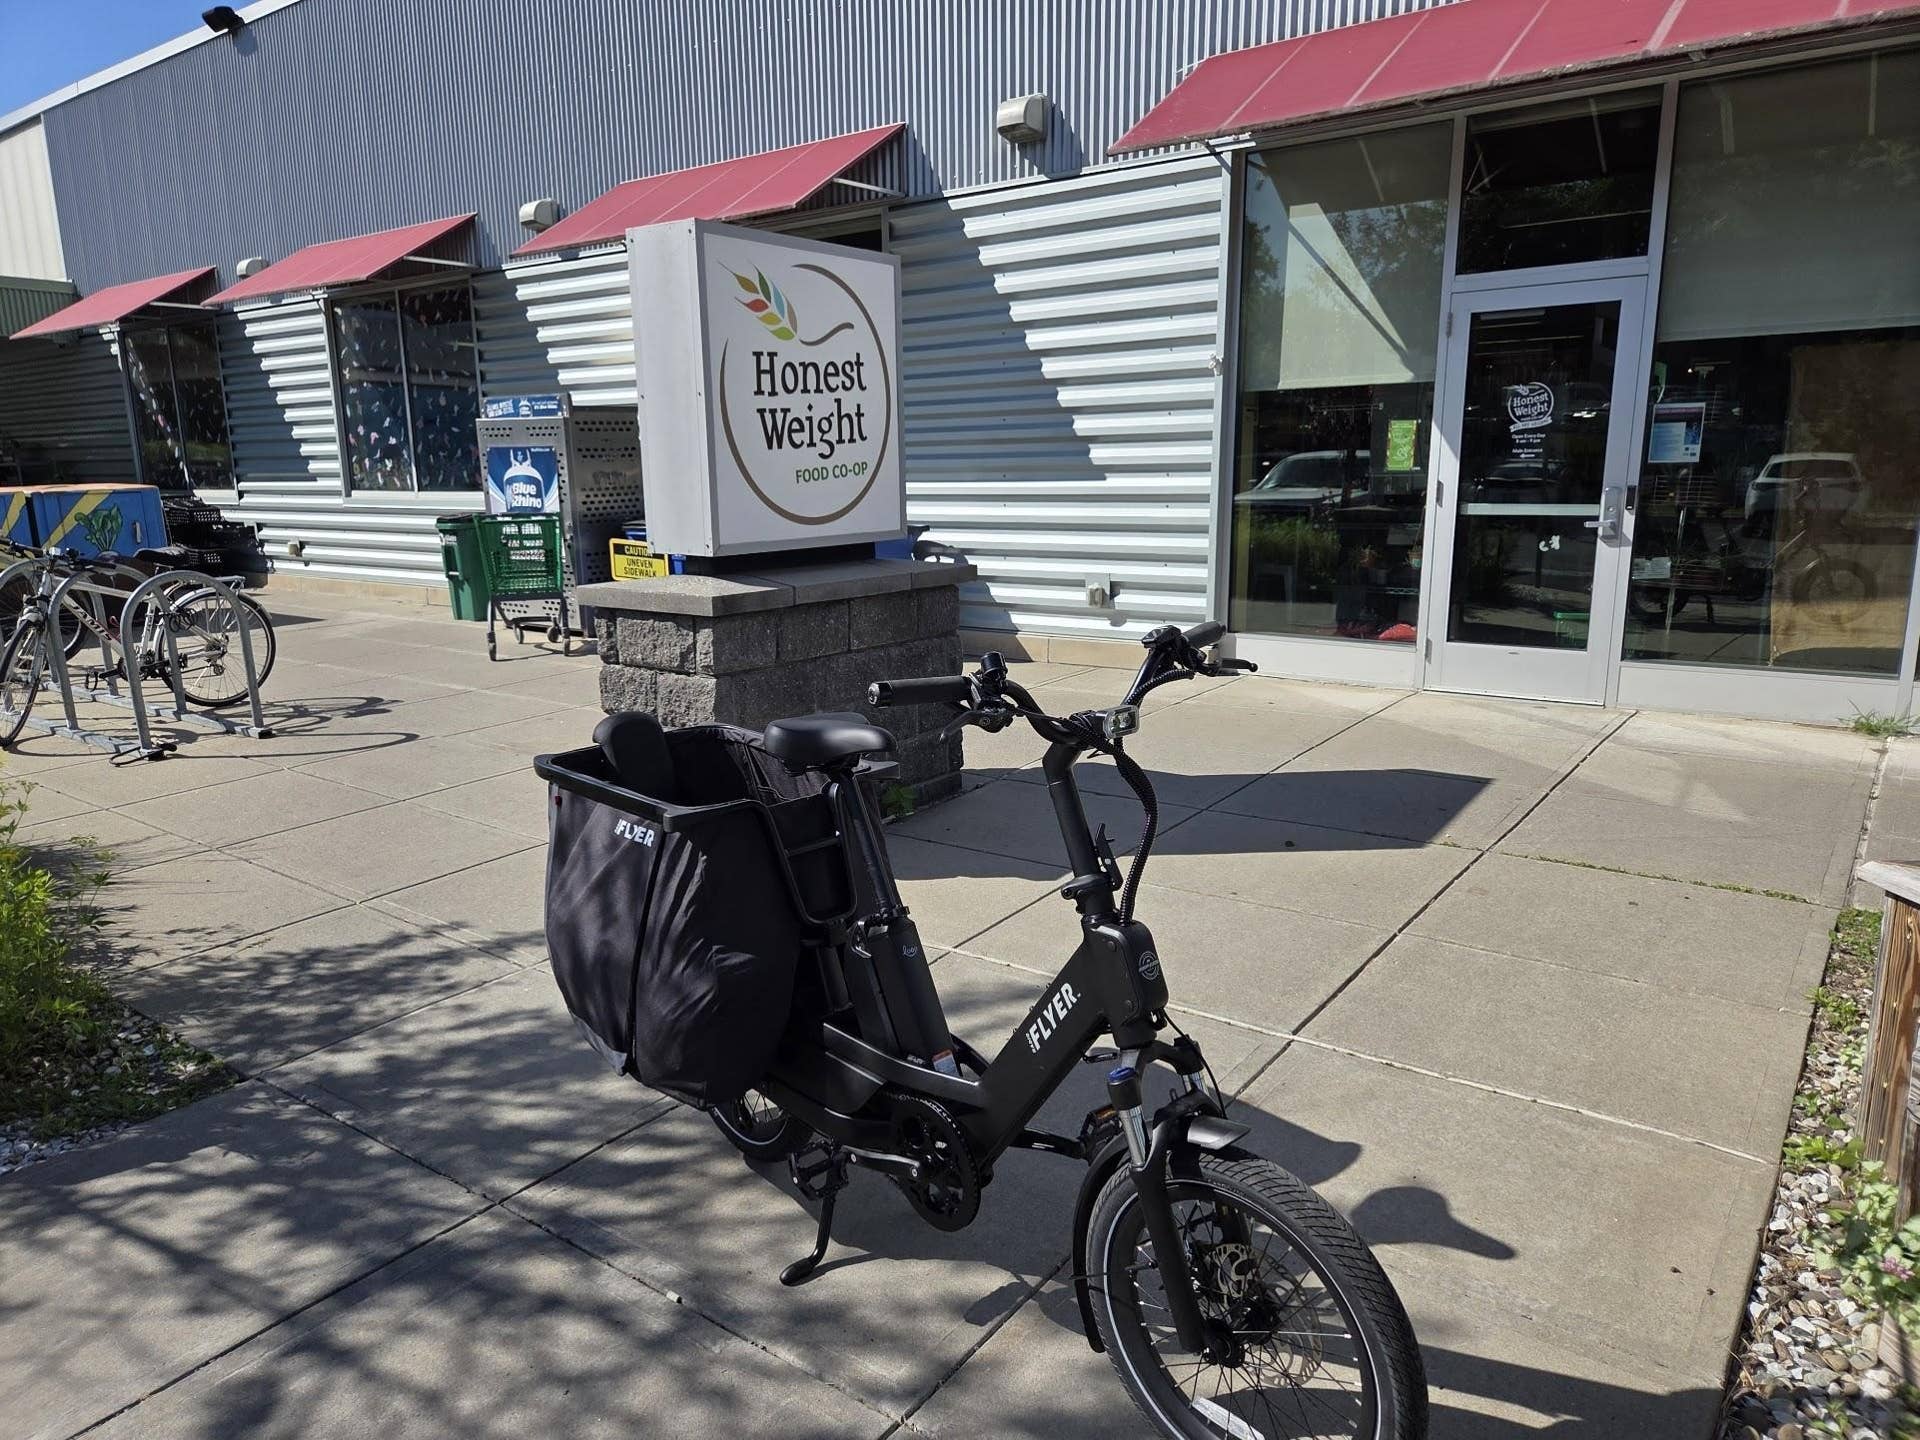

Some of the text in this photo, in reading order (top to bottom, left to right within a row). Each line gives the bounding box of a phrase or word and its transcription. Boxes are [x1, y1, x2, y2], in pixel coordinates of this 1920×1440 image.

[752, 351, 867, 397] Honest
[1513, 392, 1549, 407] Honest
[1513, 402, 1549, 417] Weight
[756, 398, 868, 460] Weight
[795, 461, 868, 483] FOOD CO-OP
[512, 482, 536, 495] Blue
[624, 566, 656, 577] SIDEWALK
[626, 558, 653, 568] UNEVEN
[615, 819, 655, 847] FLYER
[1028, 982, 1077, 1051] FLYER
